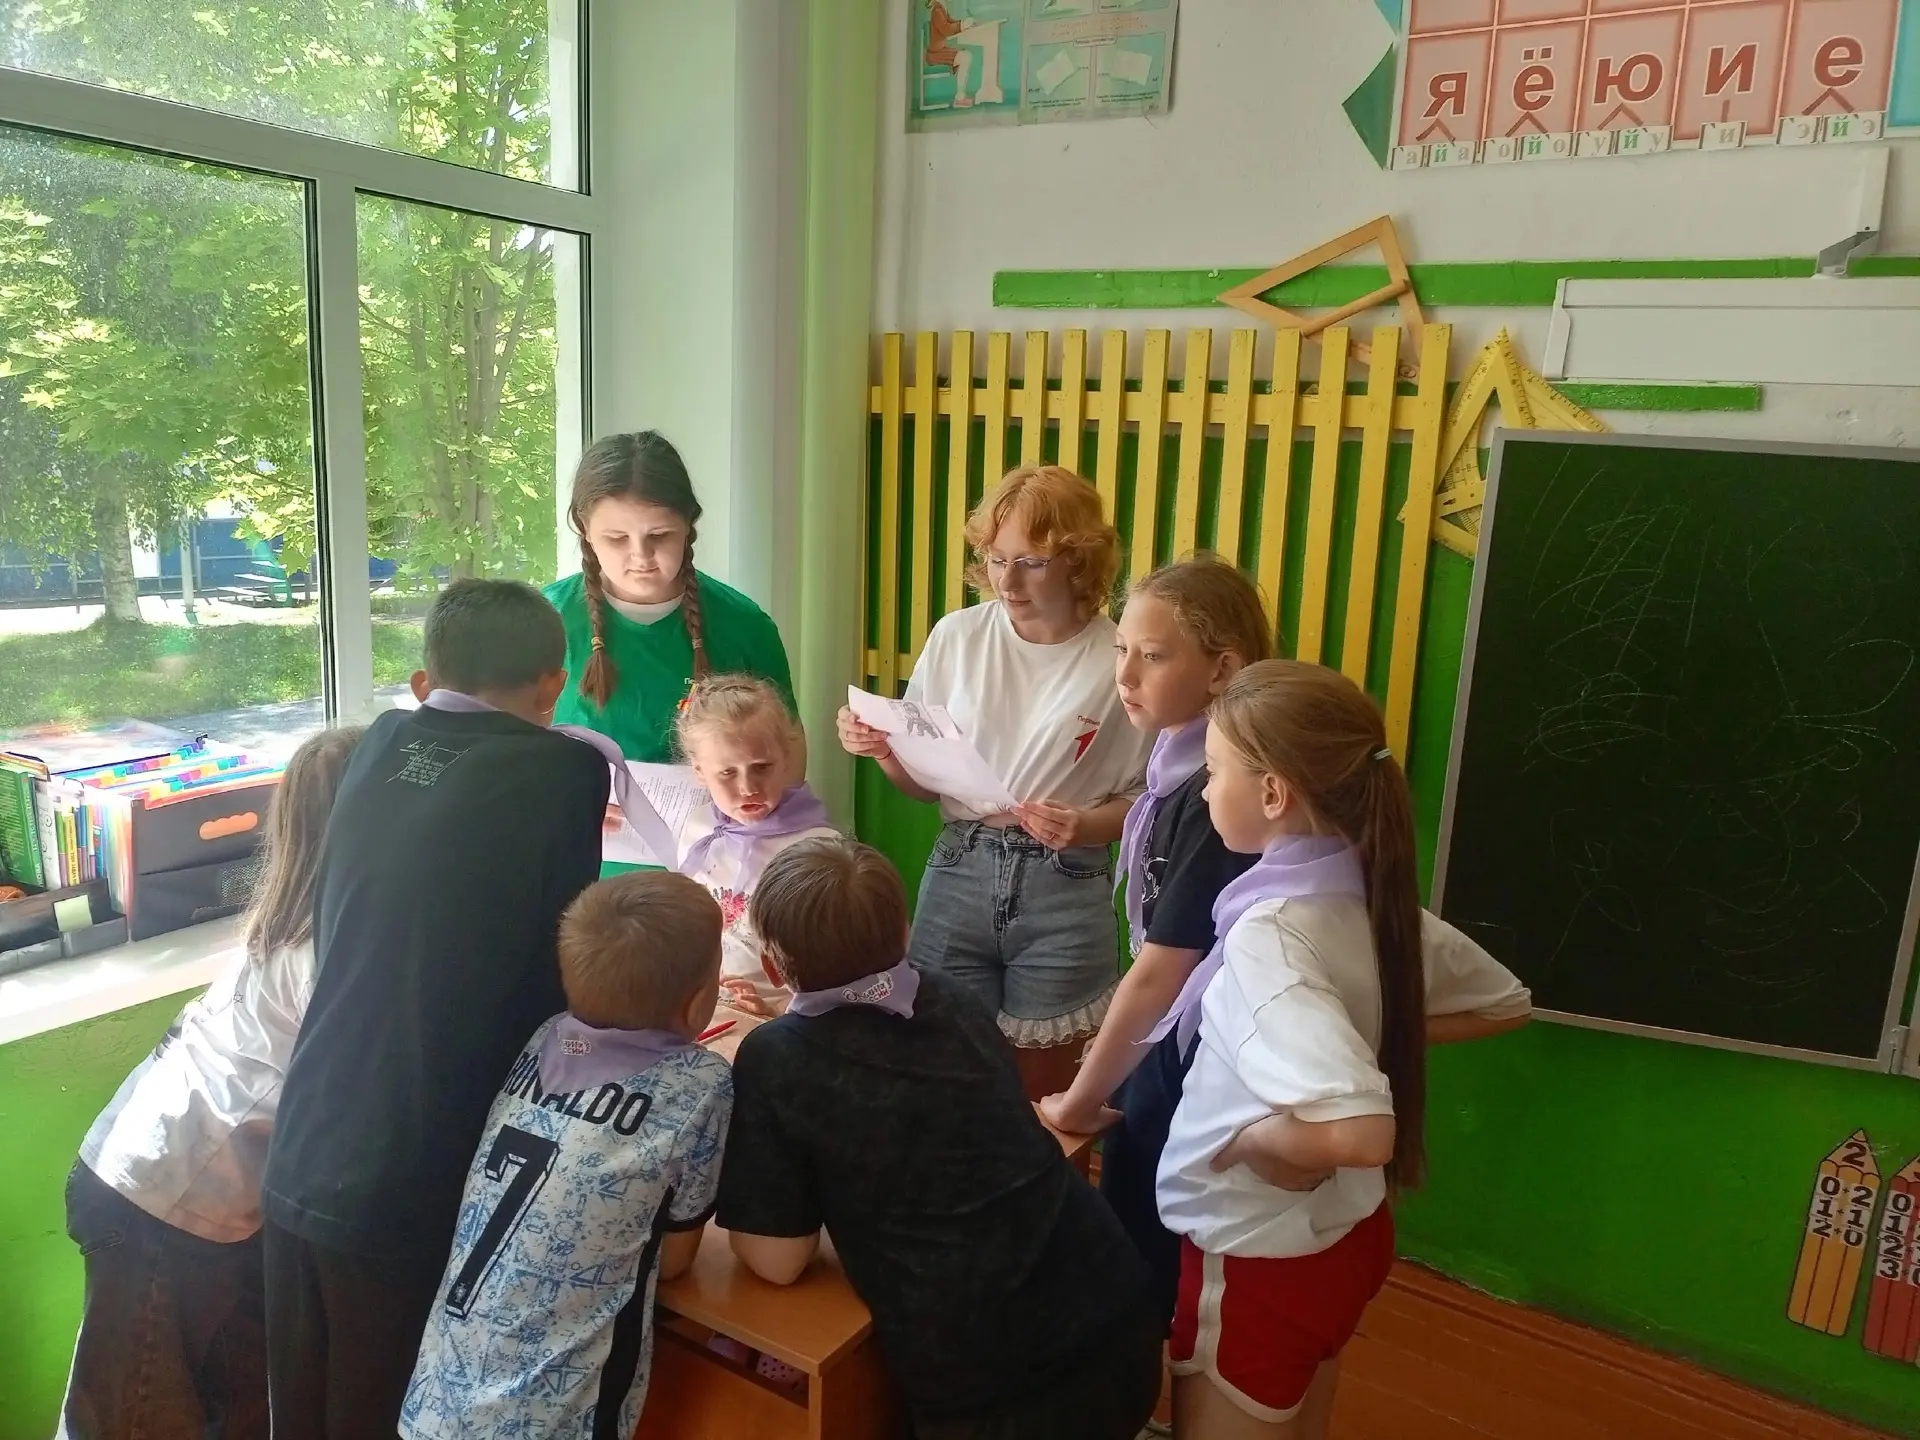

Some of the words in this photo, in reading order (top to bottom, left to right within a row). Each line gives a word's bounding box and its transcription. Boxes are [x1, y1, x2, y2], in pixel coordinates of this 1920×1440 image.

[1422, 71, 1468, 118] я
[1513, 46, 1555, 111] ё
[1594, 53, 1664, 105] ю
[1704, 43, 1757, 96] и
[1813, 36, 1864, 87] е
[1842, 1142, 1866, 1168] 2
[445, 1123, 561, 1321] 7
